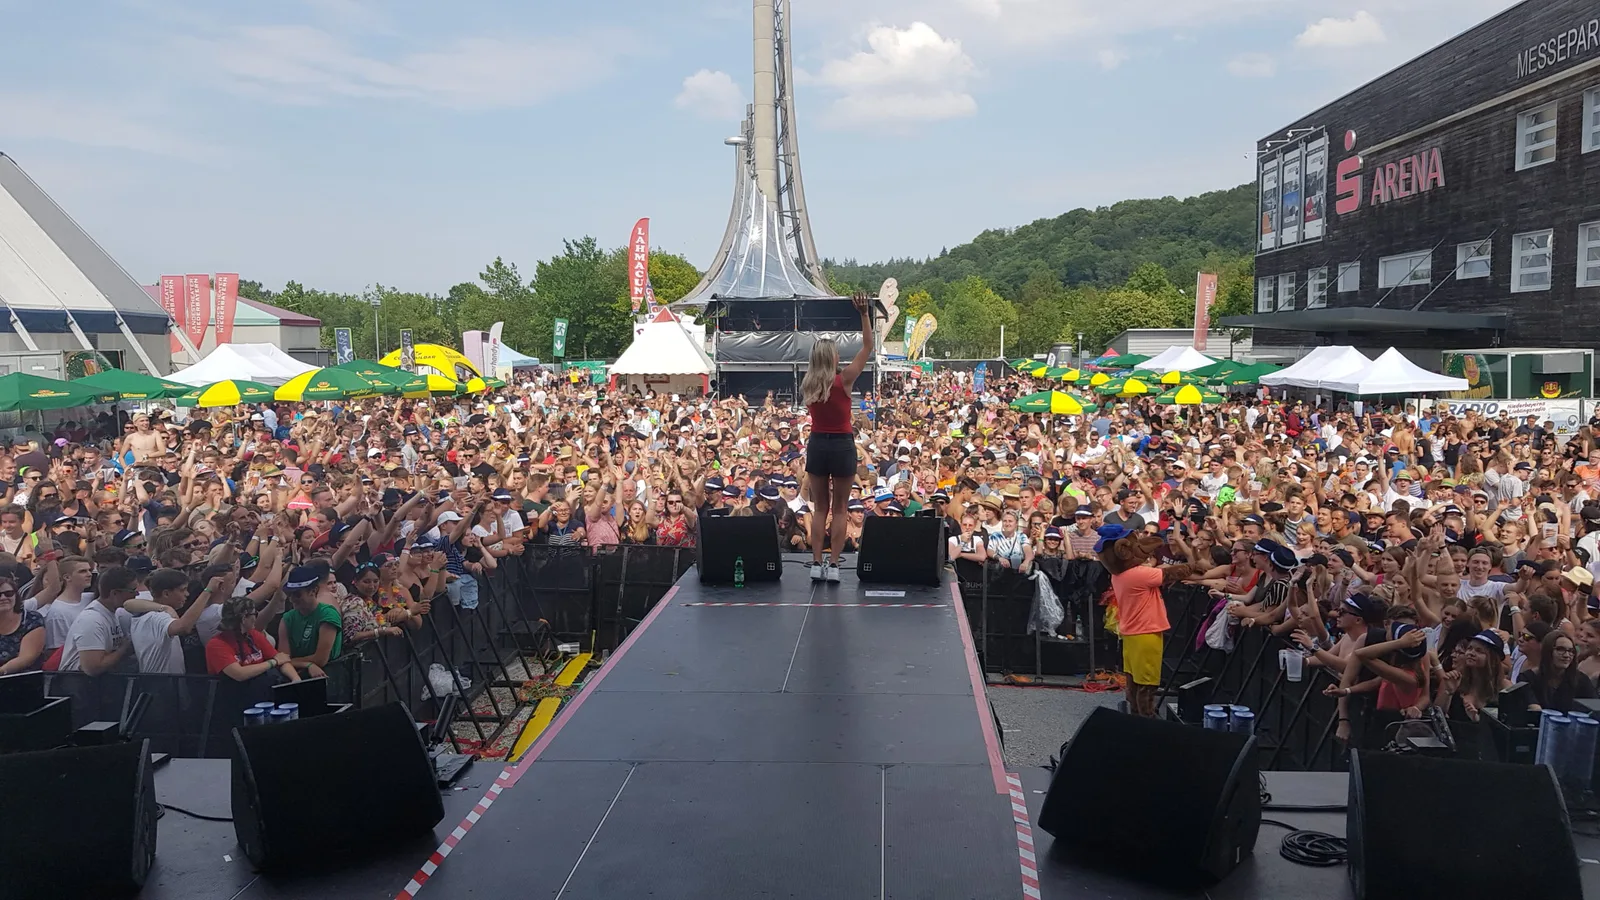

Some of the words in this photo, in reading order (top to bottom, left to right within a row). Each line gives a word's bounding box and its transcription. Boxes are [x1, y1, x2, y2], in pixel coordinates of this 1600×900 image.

[1517, 18, 1600, 79] MESSEPAR
[1370, 147, 1446, 206] ARENA
[634, 227, 646, 295] LAHMACUN
[189, 278, 197, 334] LANDESTHEATER
[219, 277, 228, 333] NIEDERBAYERN
